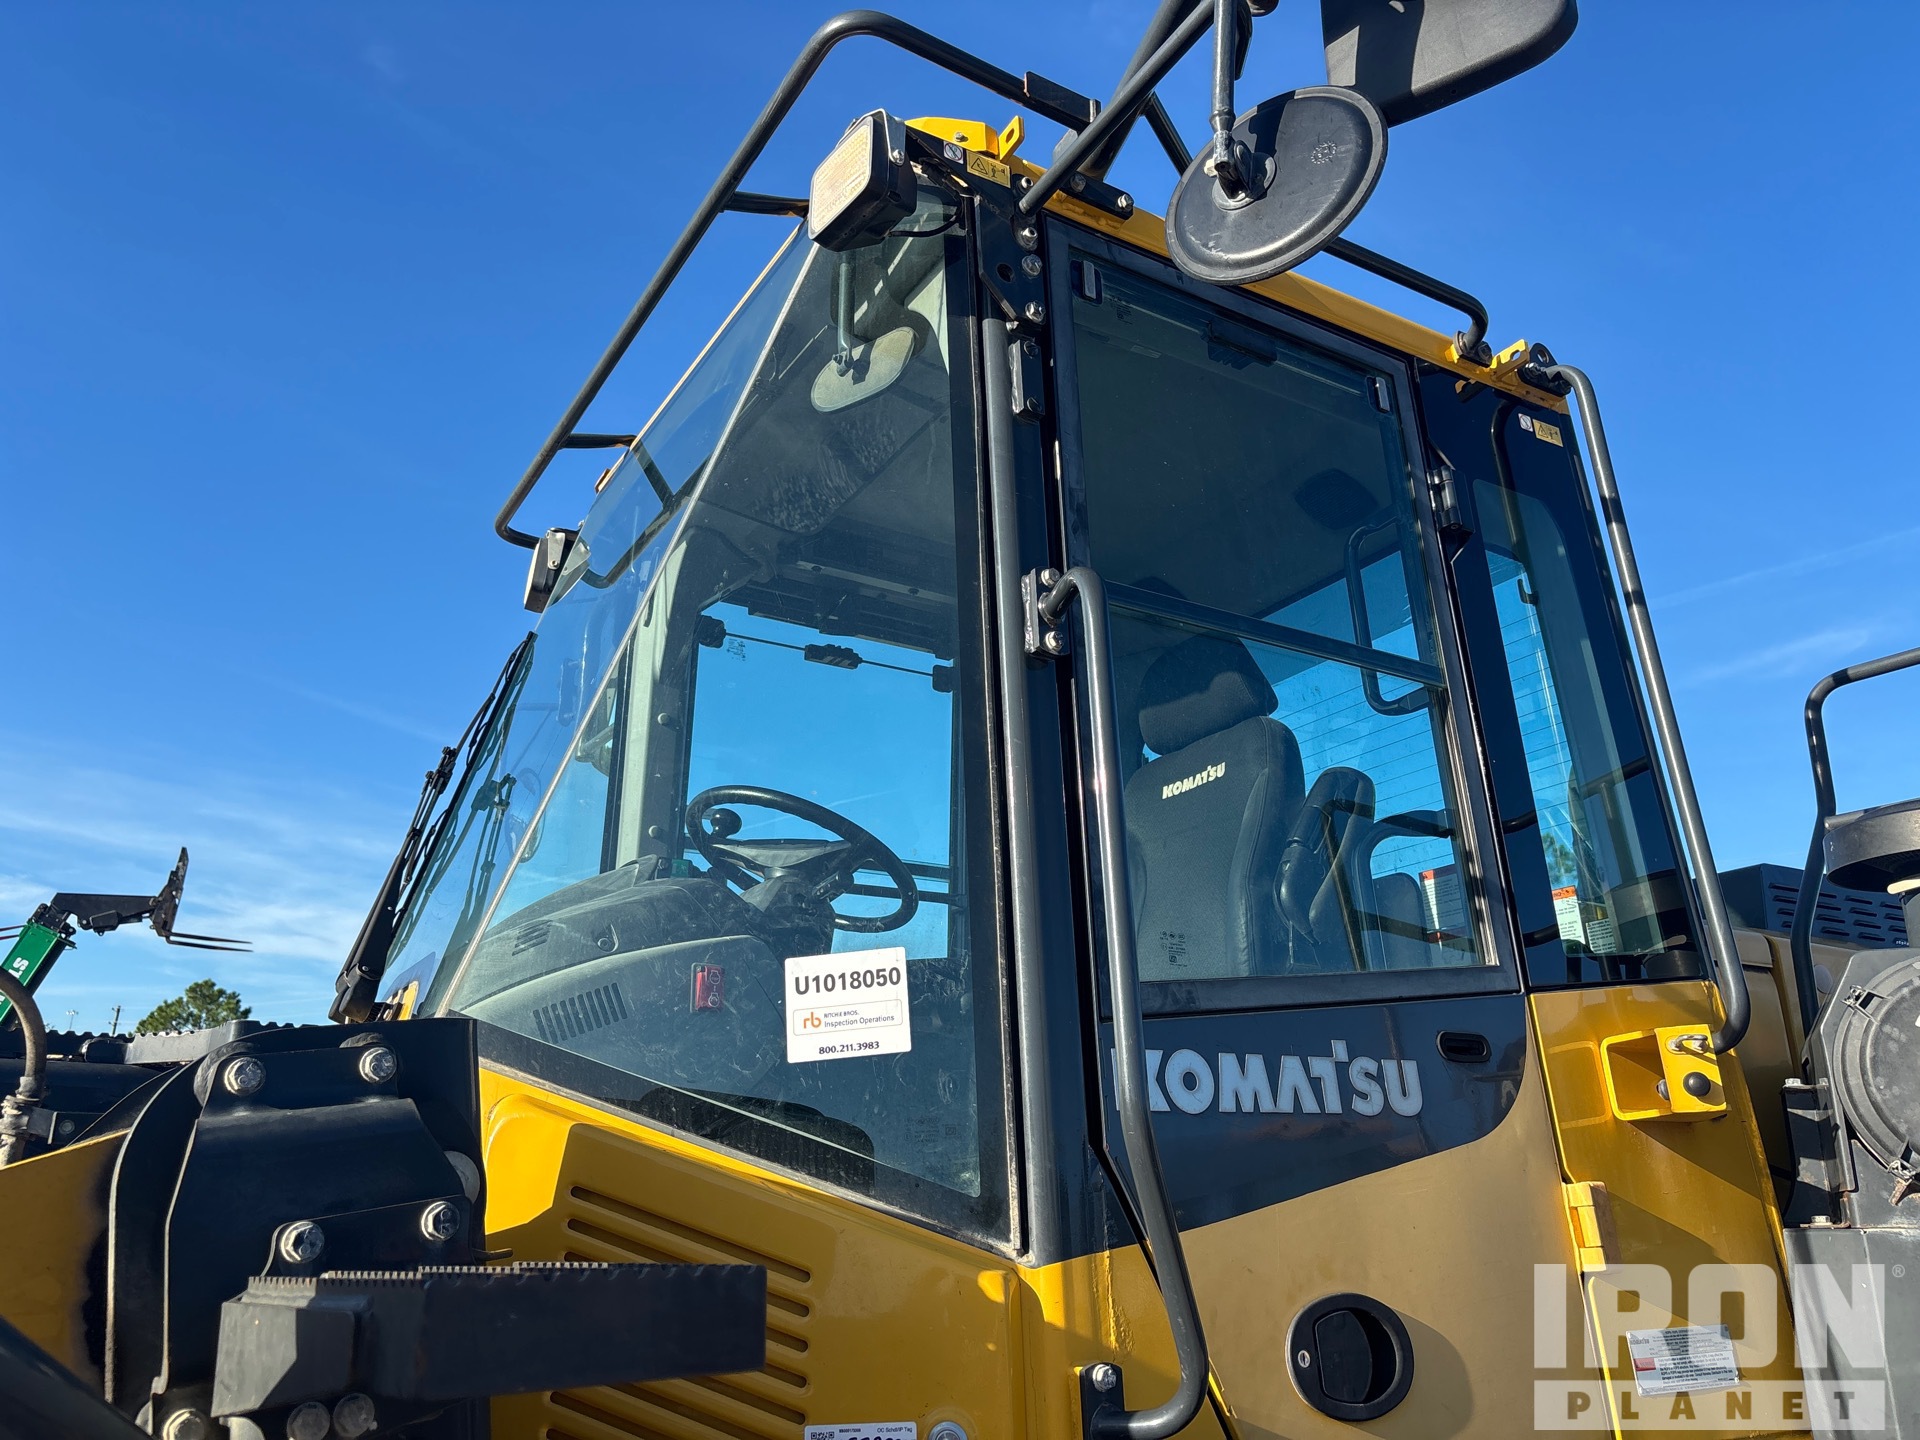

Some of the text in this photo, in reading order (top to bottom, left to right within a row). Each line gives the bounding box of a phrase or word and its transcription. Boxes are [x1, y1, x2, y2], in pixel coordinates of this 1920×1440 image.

[1162, 761, 1226, 800] KOMATSU
[795, 966, 901, 996] U1018050
[803, 1011, 822, 1029] rb
[824, 1015, 895, 1029] Inspection Operations
[818, 1040, 880, 1055] 800.211.3983
